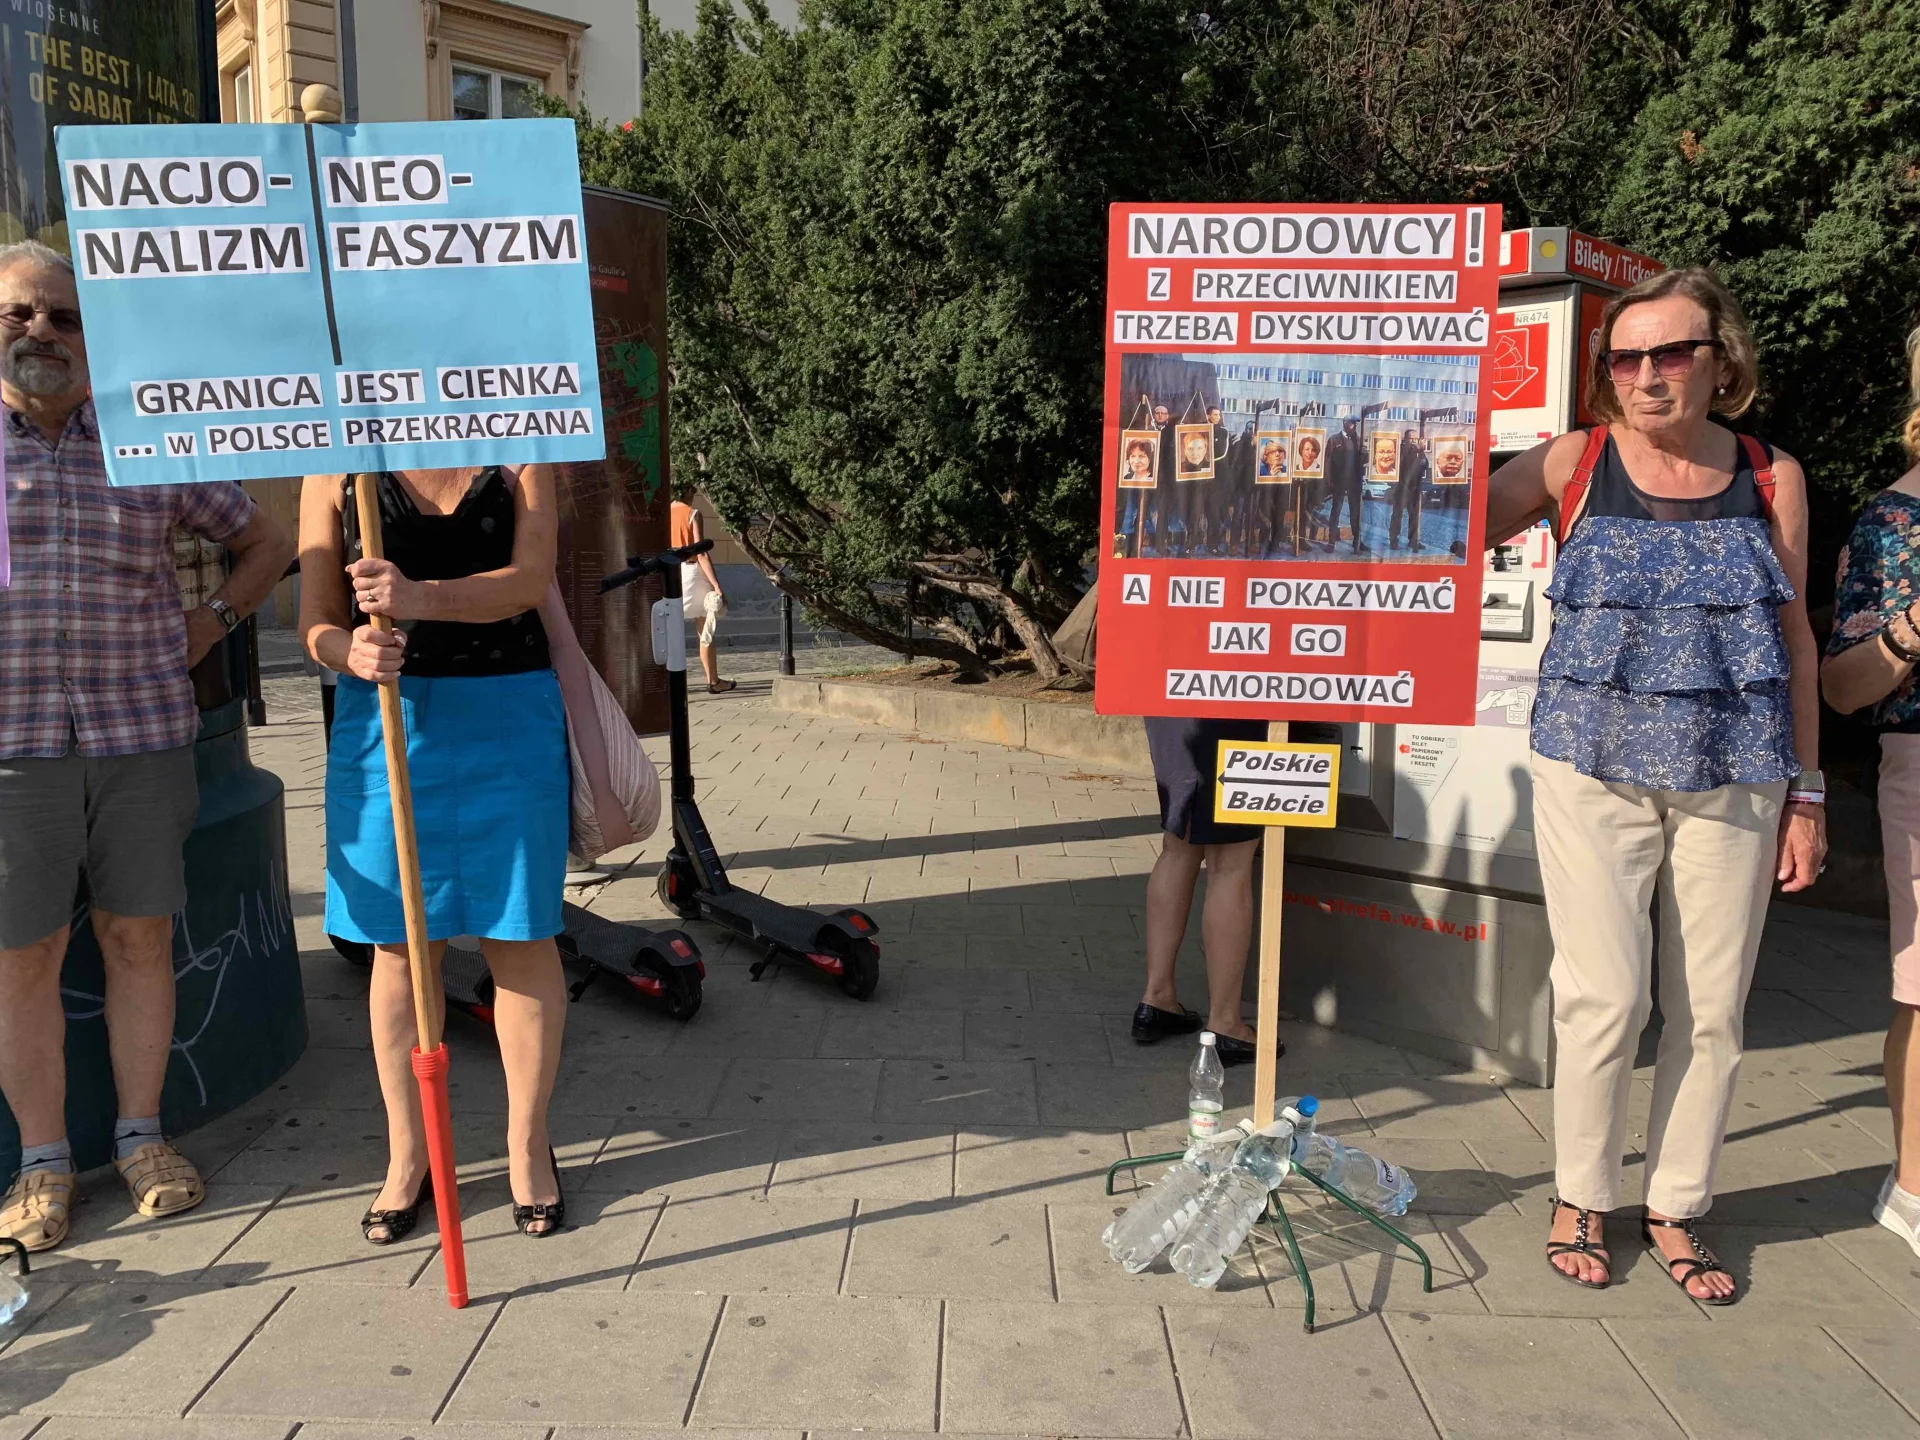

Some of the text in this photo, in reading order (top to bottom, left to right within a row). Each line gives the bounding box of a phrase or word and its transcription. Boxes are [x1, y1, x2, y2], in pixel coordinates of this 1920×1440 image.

[11, 0, 99, 35] WIOSENNE
[24, 30, 130, 89] THE BEST
[29, 72, 59, 106] OF
[68, 81, 132, 124] SABAT
[148, 71, 179, 111] LATA
[72, 160, 293, 209] NACJO-
[327, 158, 473, 204] NEO-
[83, 225, 305, 276] NALIZM
[335, 217, 578, 269] FASZYZM
[1133, 216, 1453, 256] NARODOWCY
[1574, 239, 1613, 281] Bilety
[1149, 271, 1455, 301] Z PRZECIWNIKIEM
[1115, 308, 1485, 343] TRZEBA DYSKUTOWAĆ
[135, 364, 579, 415] GRANICA JEST CIENKA
[208, 421, 331, 454] POLSCE
[344, 409, 592, 446] PRZEKRACZANA
[1124, 576, 1453, 611] A NIE POKAZYWAĆ
[1210, 625, 1343, 654] JAK GO
[1168, 671, 1411, 705] ZAMORDOWAĆ
[1225, 749, 1331, 775] Polskie
[1411, 747, 1443, 755] PAPIEROWY
[1226, 790, 1325, 815] Babcie
